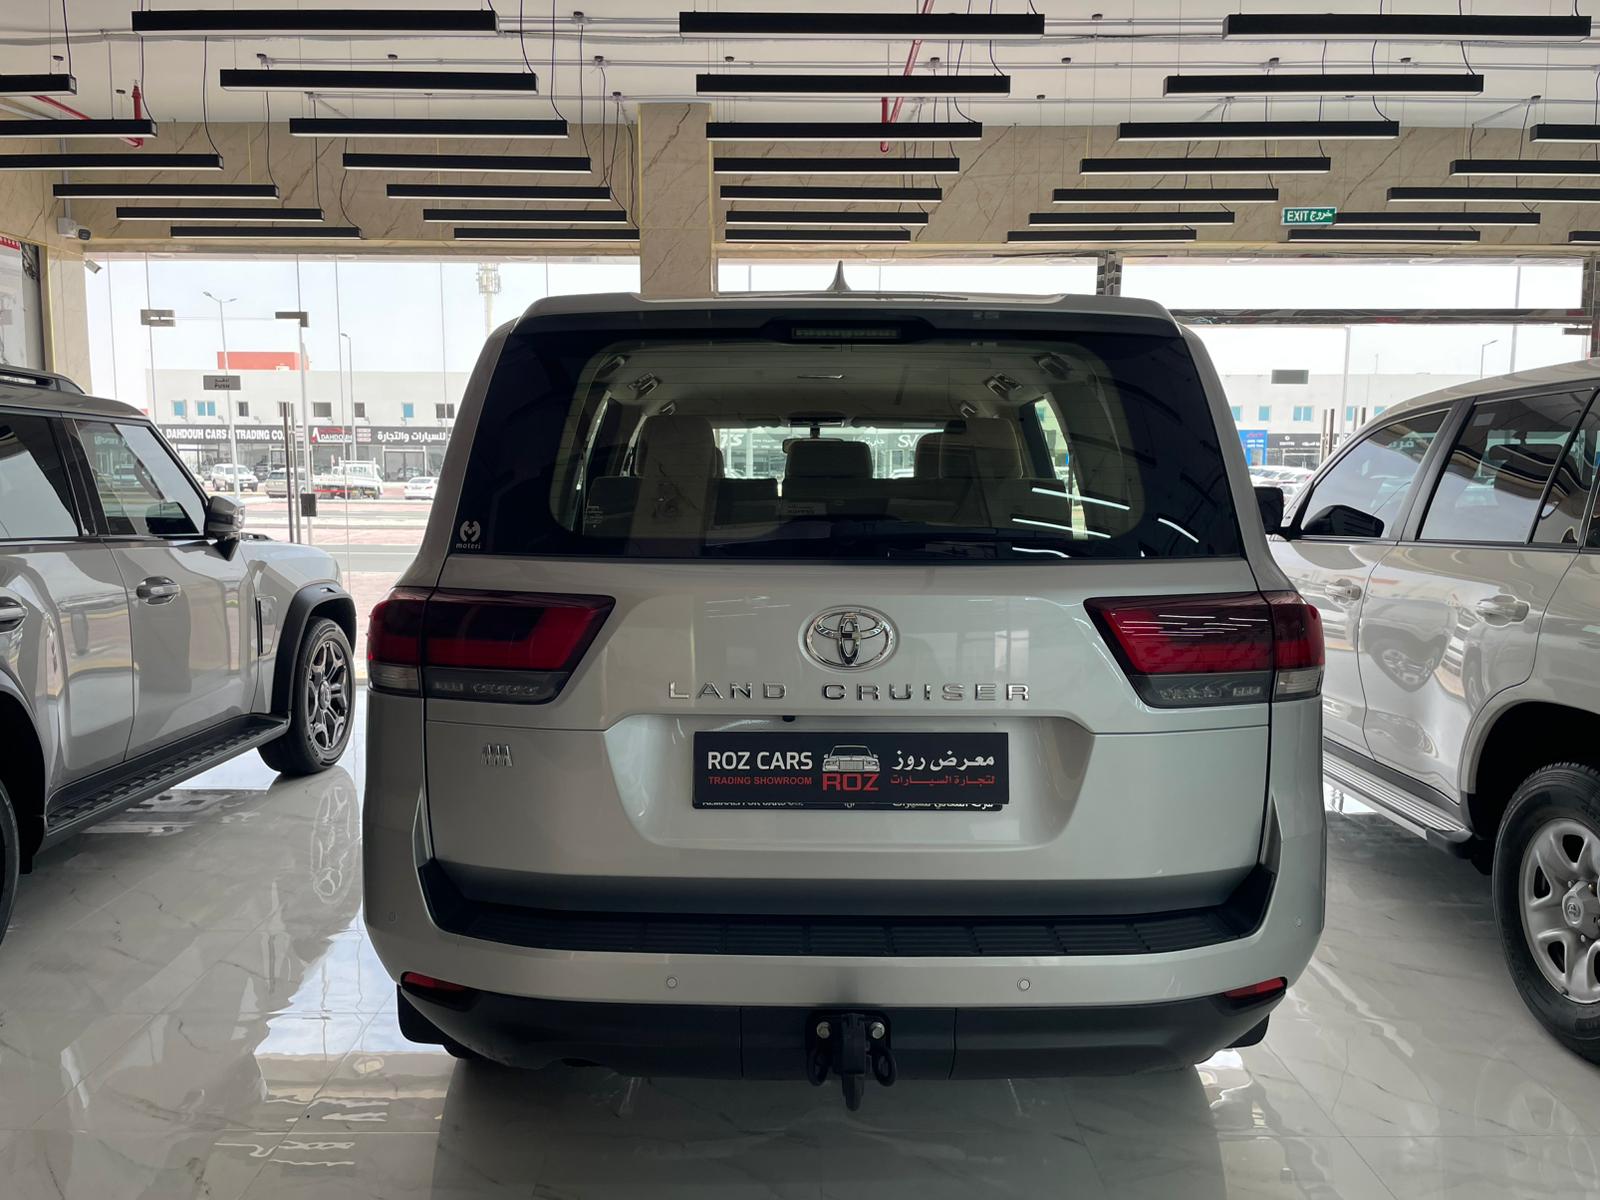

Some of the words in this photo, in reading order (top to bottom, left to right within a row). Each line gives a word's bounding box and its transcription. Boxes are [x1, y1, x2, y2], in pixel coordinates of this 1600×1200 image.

[1287, 210, 1309, 222] EXIT
[1309, 209, 1333, 222] خروج
[165, 428, 204, 440] DAHDOUH
[205, 428, 226, 440] CARS
[236, 429, 270, 441] TRADING
[377, 430, 410, 443] والتجارة
[410, 431, 446, 443] للسيارات
[668, 681, 788, 701] LAND
[821, 681, 1031, 702] CRUISER
[707, 751, 751, 770] ROZ
[756, 751, 813, 770] CARS
[891, 750, 926, 771] روز
[929, 750, 995, 772] معرض
[708, 776, 752, 785] TRADING
[753, 776, 812, 785] SHOWROOM
[821, 773, 880, 791] ROZ
[889, 774, 952, 787] السيارات
[953, 774, 996, 788] لتجارة
